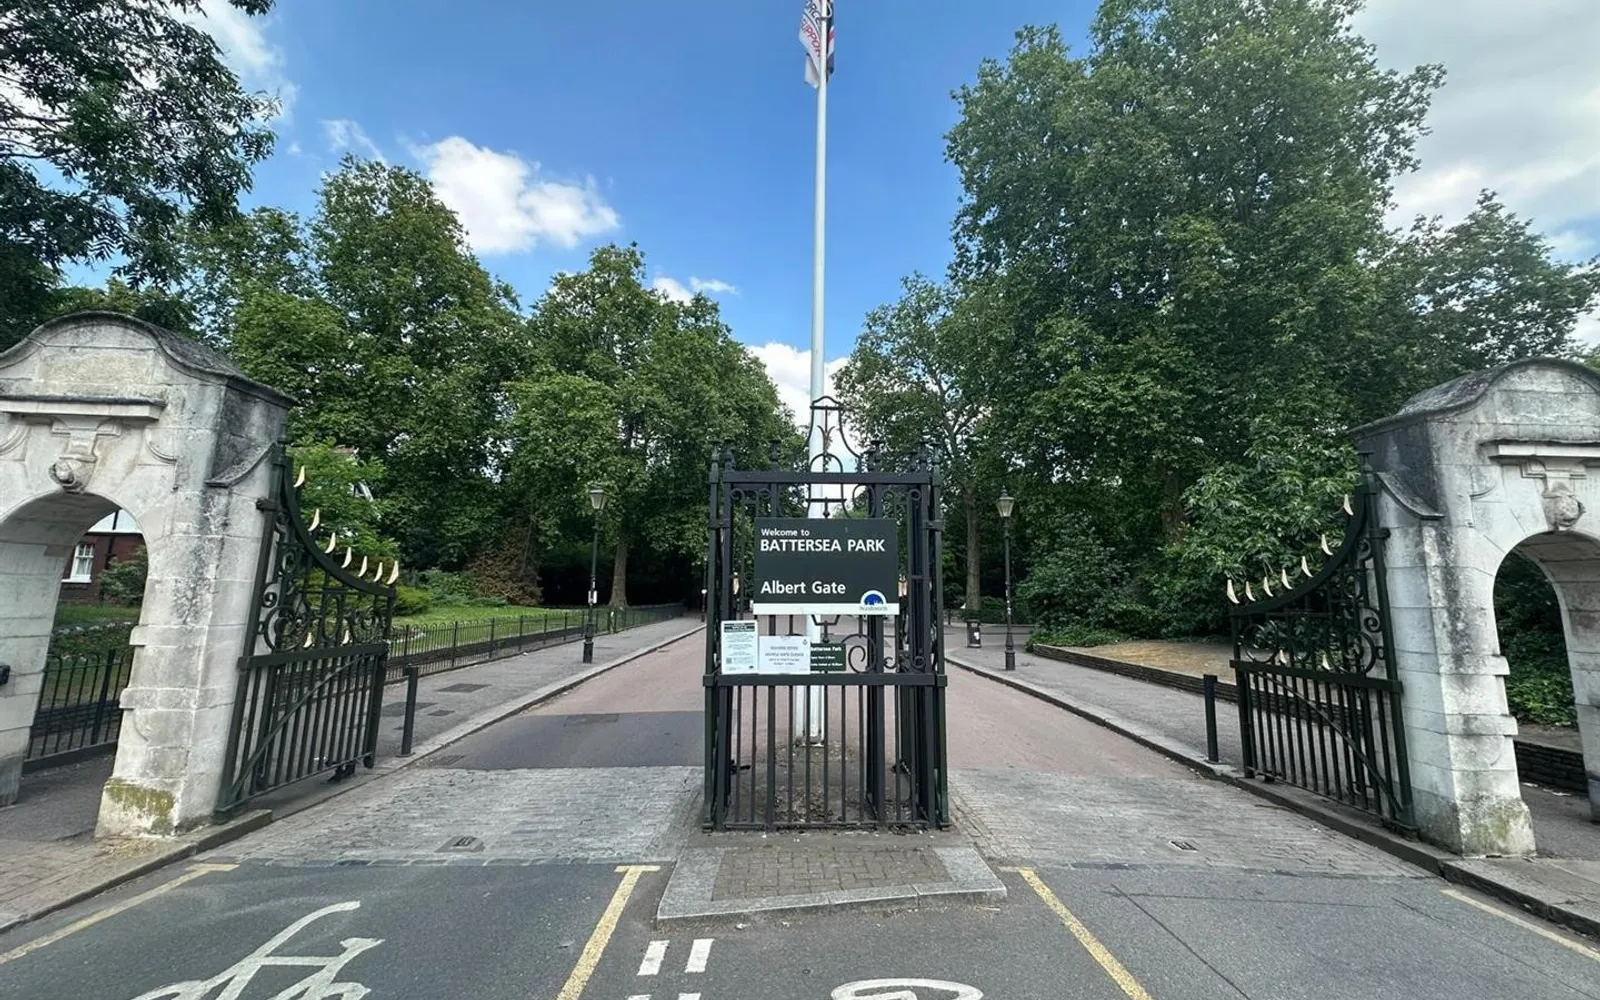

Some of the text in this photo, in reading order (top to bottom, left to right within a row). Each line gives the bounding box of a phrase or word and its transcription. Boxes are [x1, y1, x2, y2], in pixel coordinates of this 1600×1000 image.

[761, 528, 798, 536] Welcome
[760, 539, 886, 552] BATTERSEA PARK
[760, 580, 847, 594] Albert Gate
